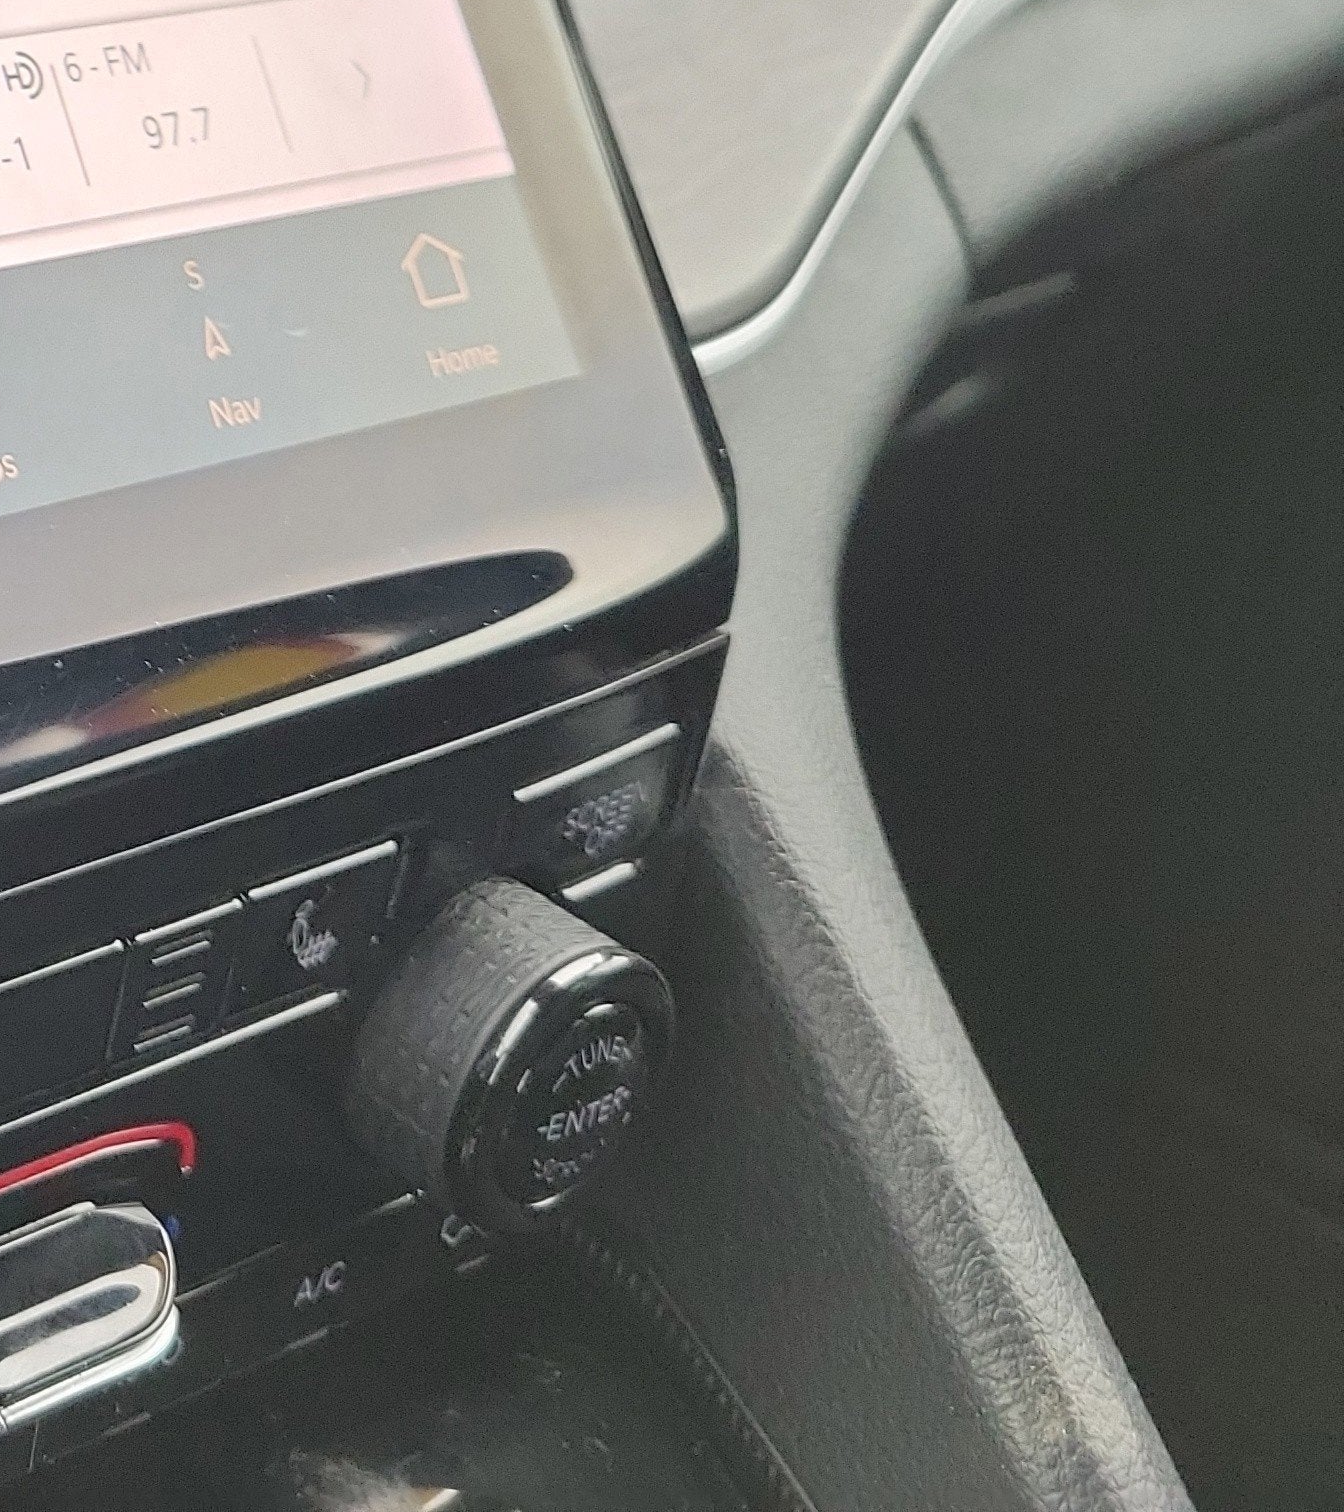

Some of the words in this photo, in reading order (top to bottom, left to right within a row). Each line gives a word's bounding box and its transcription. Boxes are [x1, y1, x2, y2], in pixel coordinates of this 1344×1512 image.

[141, 106, 212, 150] 97.7
[182, 259, 206, 291] S
[427, 343, 500, 376] Home
[207, 395, 263, 430] Nav
[293, 1260, 347, 1308] A/C
